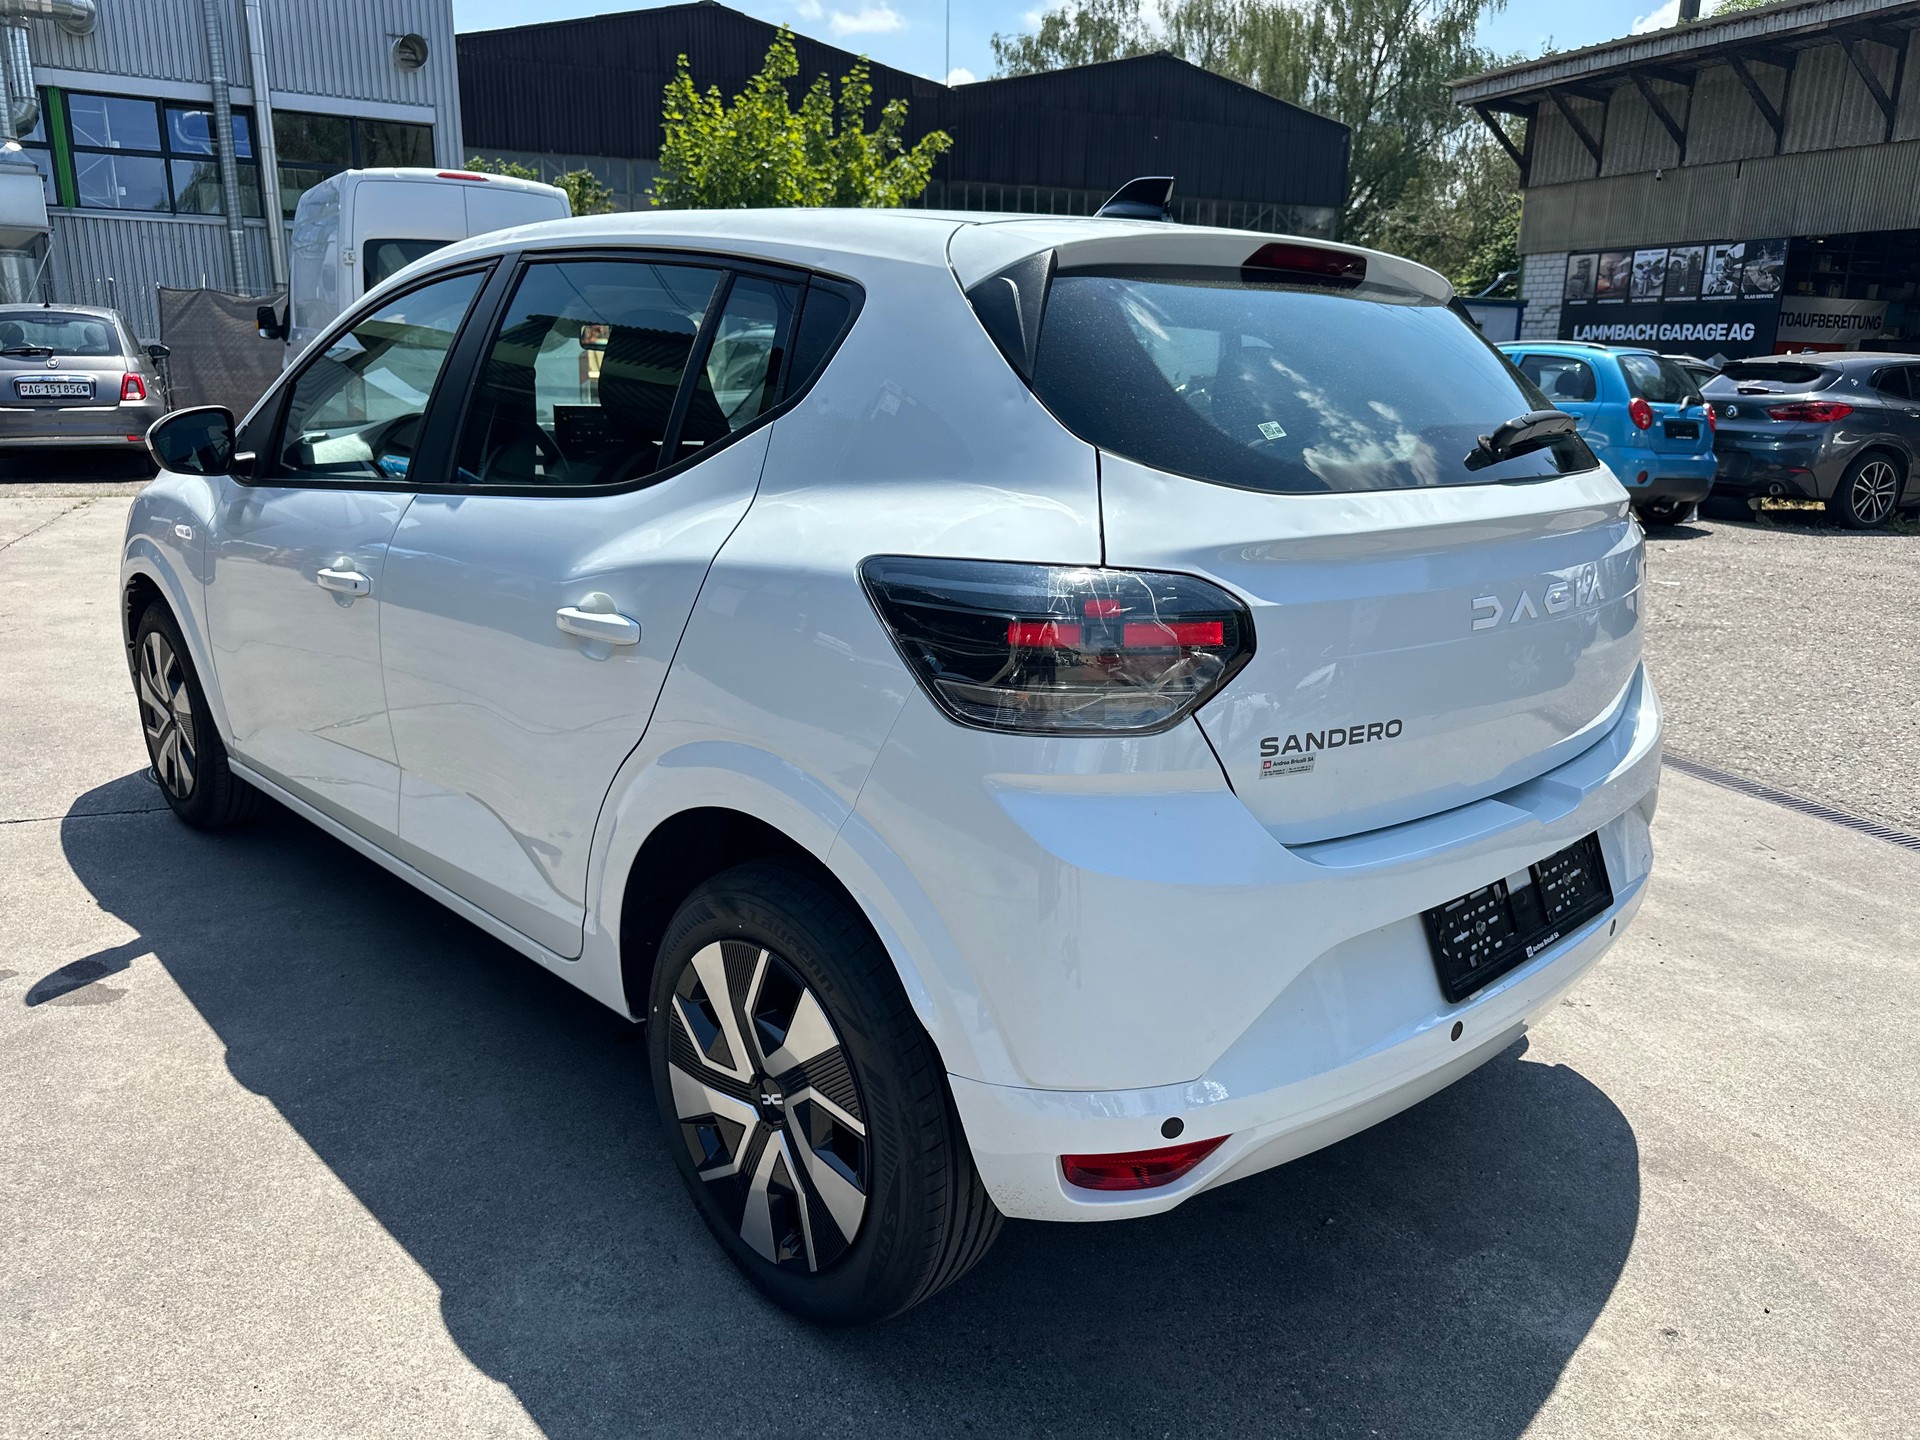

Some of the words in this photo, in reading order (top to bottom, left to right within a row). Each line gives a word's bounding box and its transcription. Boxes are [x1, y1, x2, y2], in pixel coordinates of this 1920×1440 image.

[1573, 324, 1657, 341] LAMMBACH
[1658, 323, 1727, 341] GARAGE
[1727, 323, 1755, 341] AG
[1471, 574, 1605, 631] DACIA
[1260, 719, 1403, 757] SANDERO
